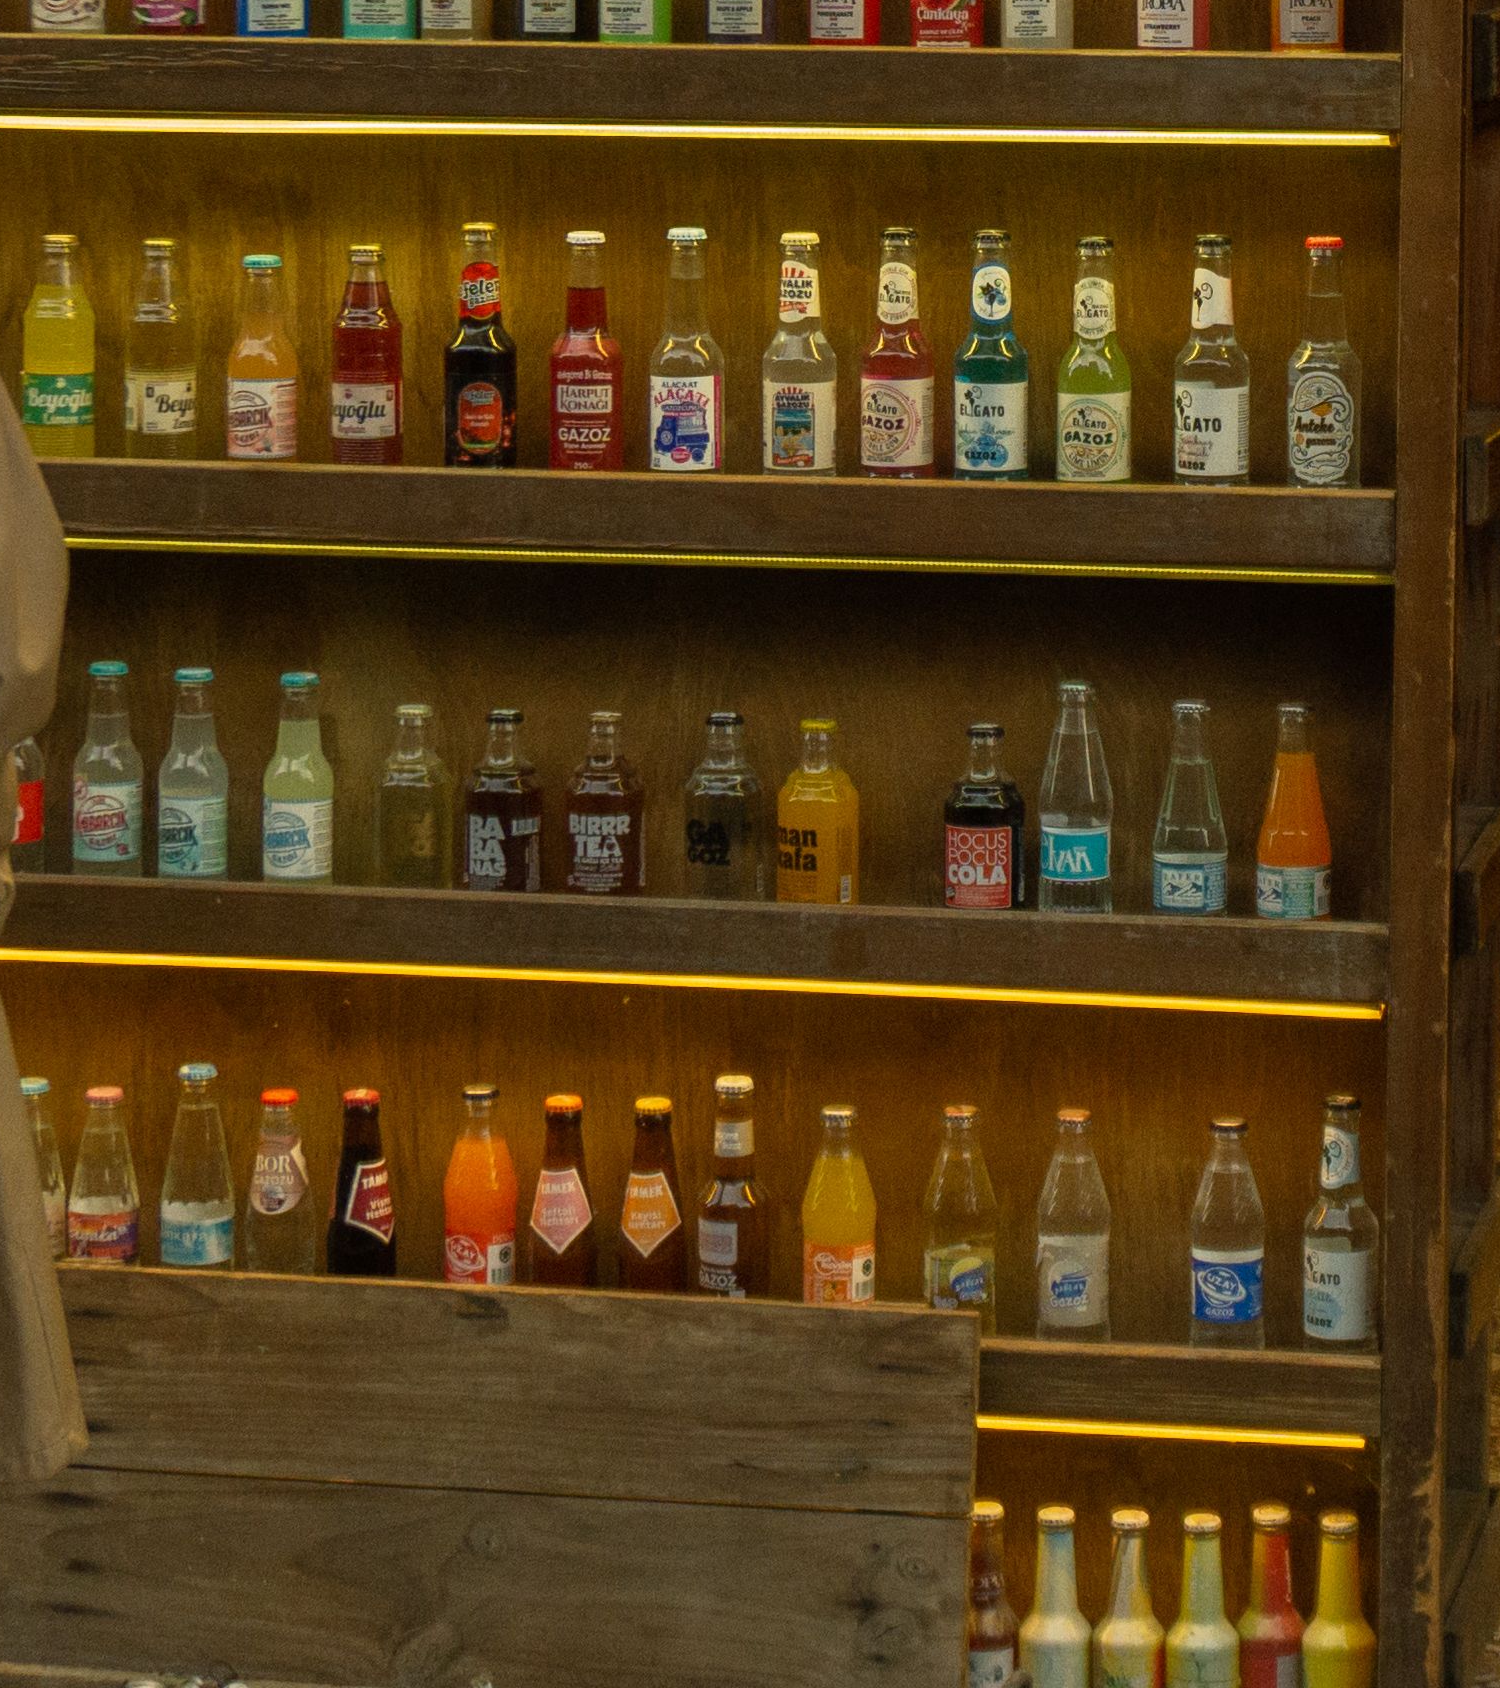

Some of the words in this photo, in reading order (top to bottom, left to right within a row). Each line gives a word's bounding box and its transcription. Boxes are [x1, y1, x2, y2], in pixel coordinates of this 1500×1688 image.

[560, 386, 610, 400] HARPUT
[876, 404, 898, 415] GATO
[974, 405, 1005, 418] GATO
[1084, 418, 1107, 430] GATO
[558, 427, 611, 441] GAZOZ
[1064, 431, 1114, 445] GAZOZ
[469, 813, 506, 840] BA
[569, 813, 630, 835] BIRRR
[469, 837, 506, 860] BA
[574, 834, 623, 858] TEA
[948, 832, 1008, 850] HOCUS
[948, 848, 1008, 866] POCUS
[469, 858, 507, 877] NAS
[948, 864, 1008, 886] COLA
[255, 1154, 292, 1172] BOR
[541, 1182, 576, 1195] TAMEK
[627, 1184, 663, 1198] TAMEK
[1206, 1271, 1237, 1290] UZAY
[1204, 1306, 1235, 1317] GAZOZ
